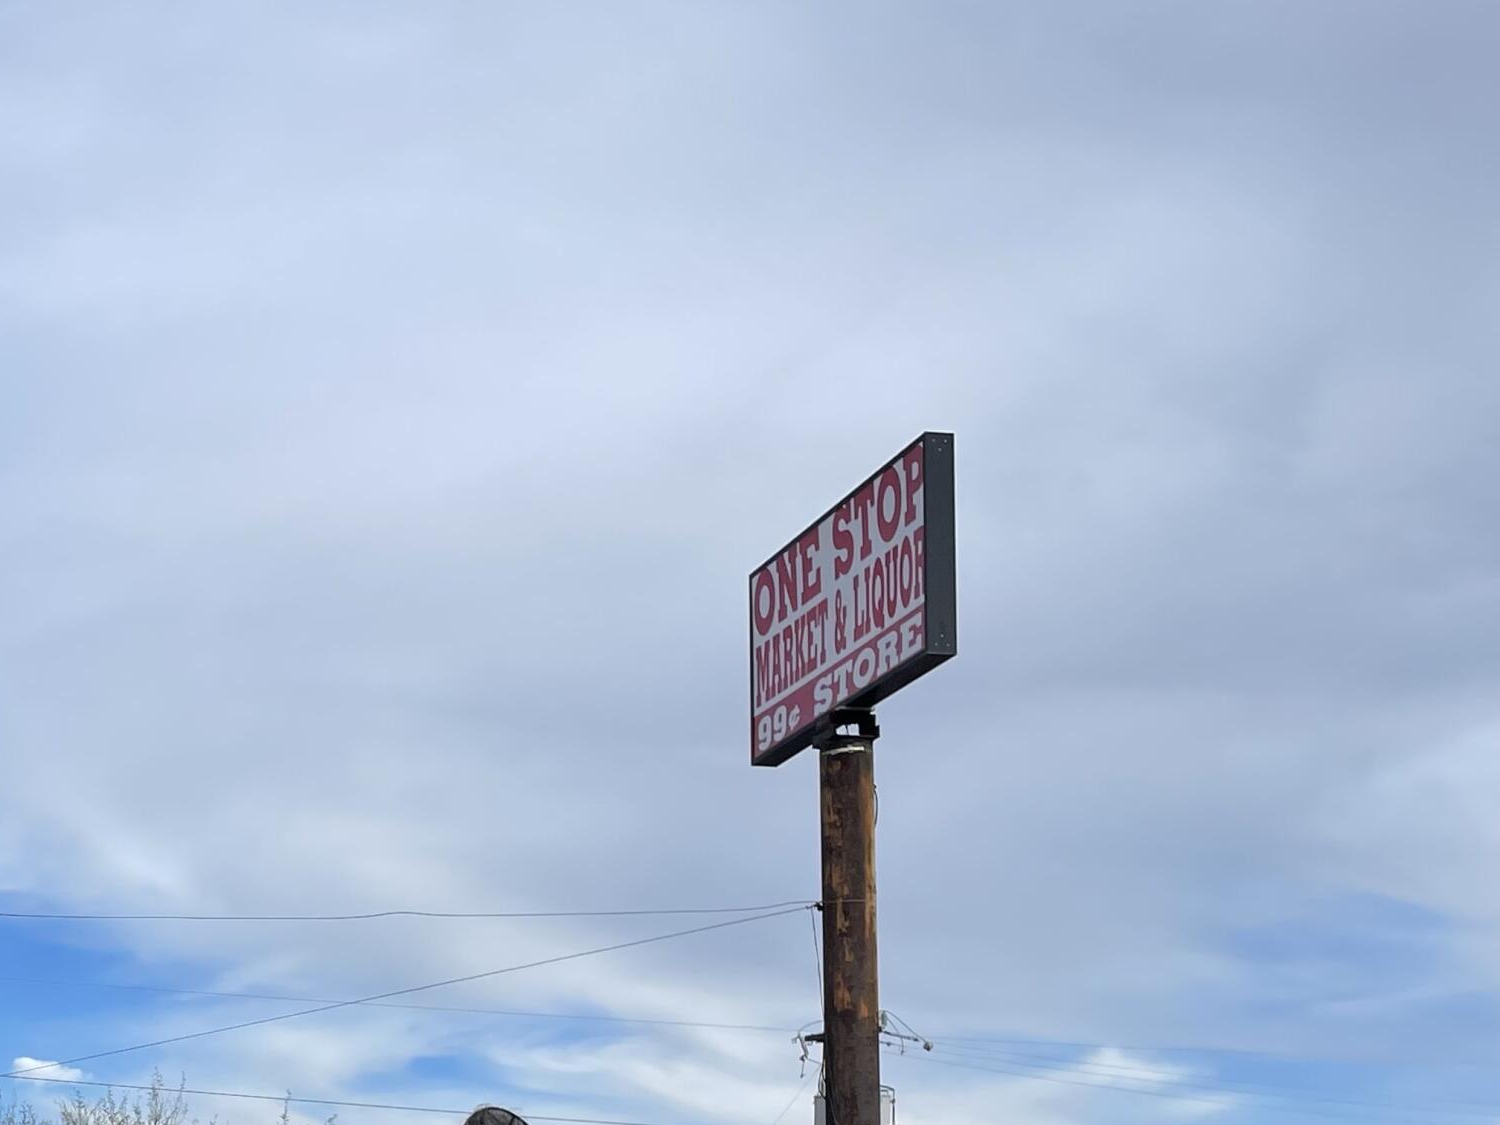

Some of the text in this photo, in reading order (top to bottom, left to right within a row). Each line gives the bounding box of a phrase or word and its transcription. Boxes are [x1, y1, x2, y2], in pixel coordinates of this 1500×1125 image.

[754, 443, 924, 636] ONE STOP
[756, 597, 828, 708] MARKET
[834, 589, 847, 655] &
[814, 611, 924, 717] STORE
